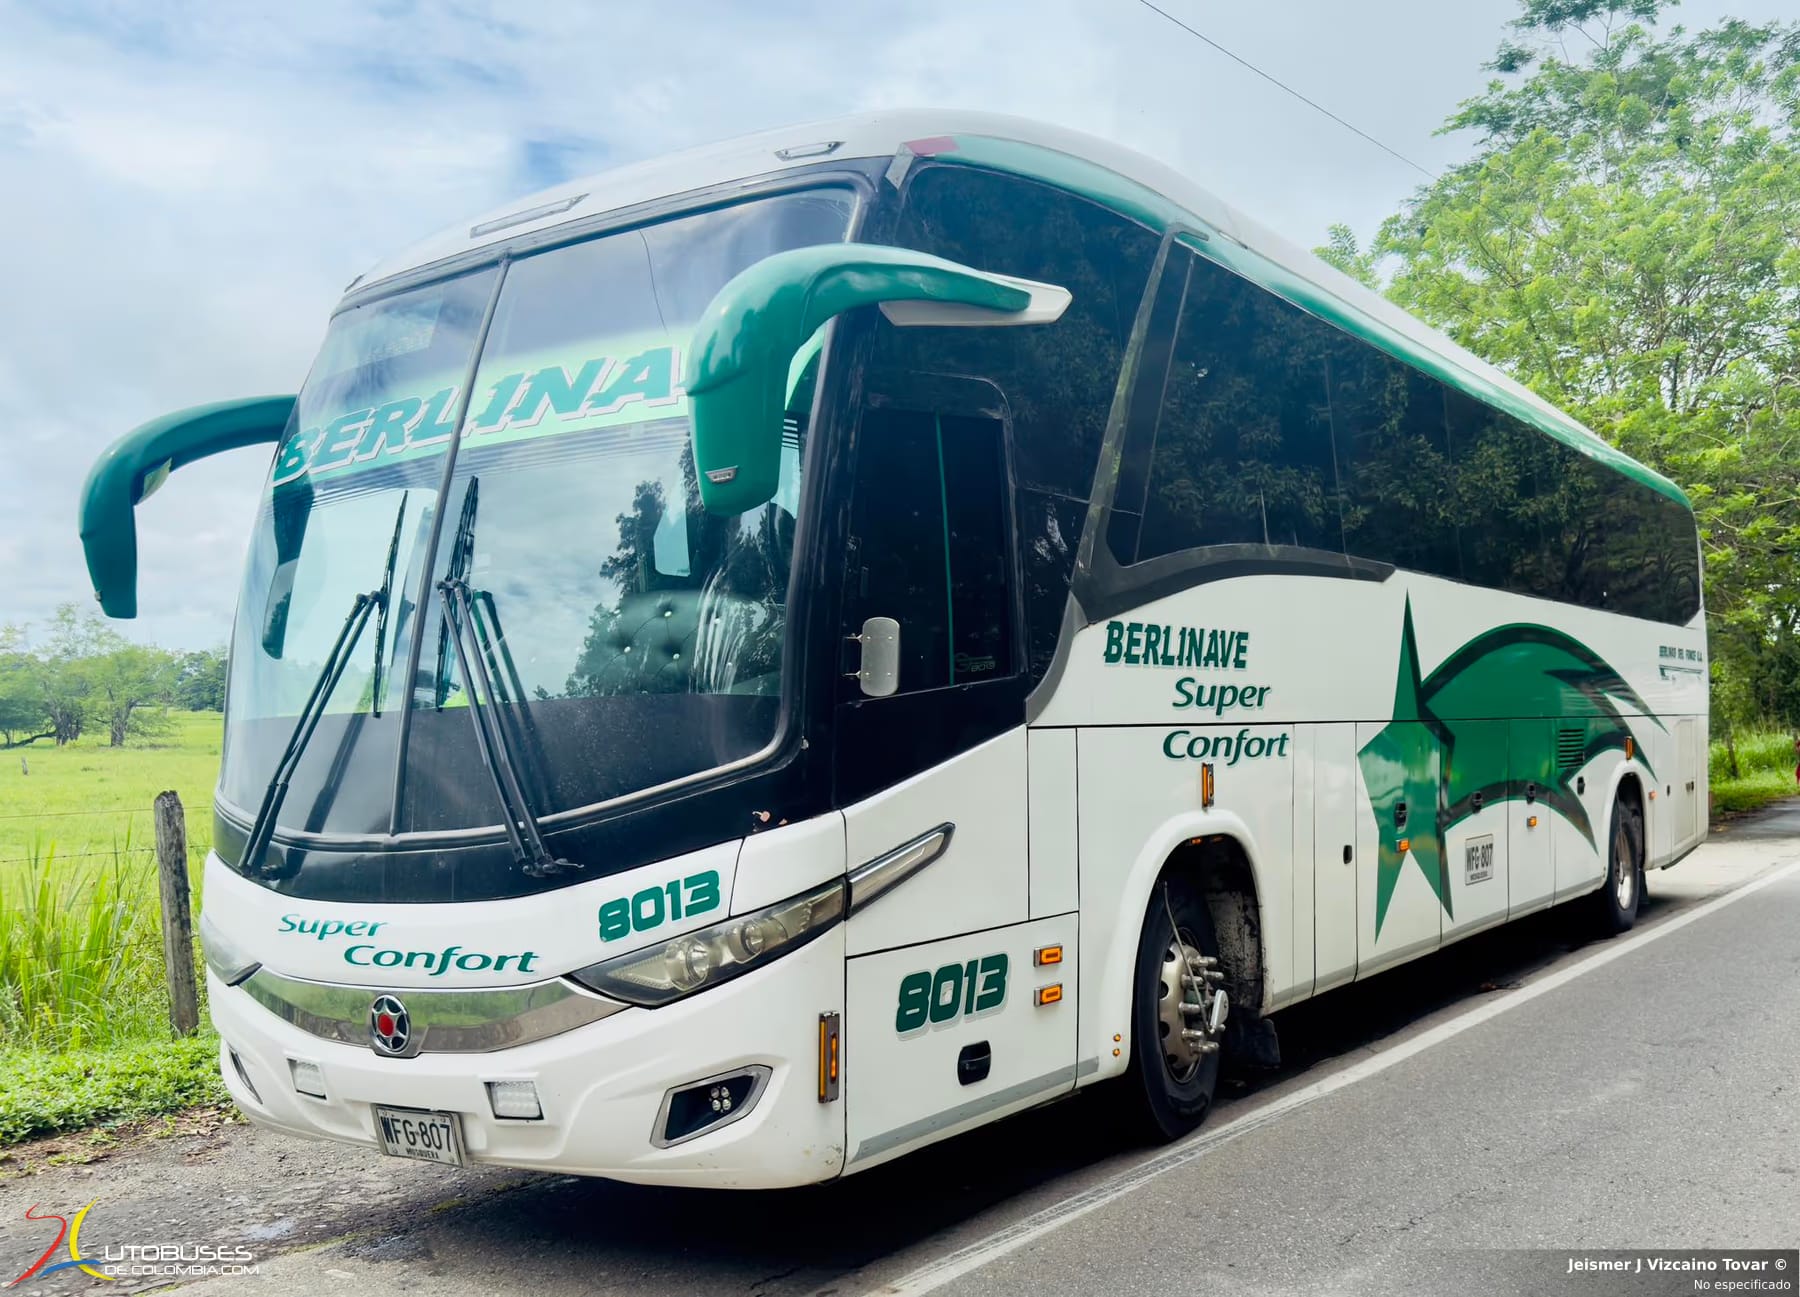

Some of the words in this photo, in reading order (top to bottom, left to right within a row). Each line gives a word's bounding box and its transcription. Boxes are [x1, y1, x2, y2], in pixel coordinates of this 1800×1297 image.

[273, 345, 691, 487] BERLINA
[1103, 620, 1250, 669] BERLINAVE
[1172, 676, 1272, 716] Super
[1162, 728, 1290, 767] Confort
[278, 913, 389, 941] Super
[598, 869, 721, 943] 8013
[343, 944, 541, 977] Confort
[896, 953, 1009, 1035] 8013
